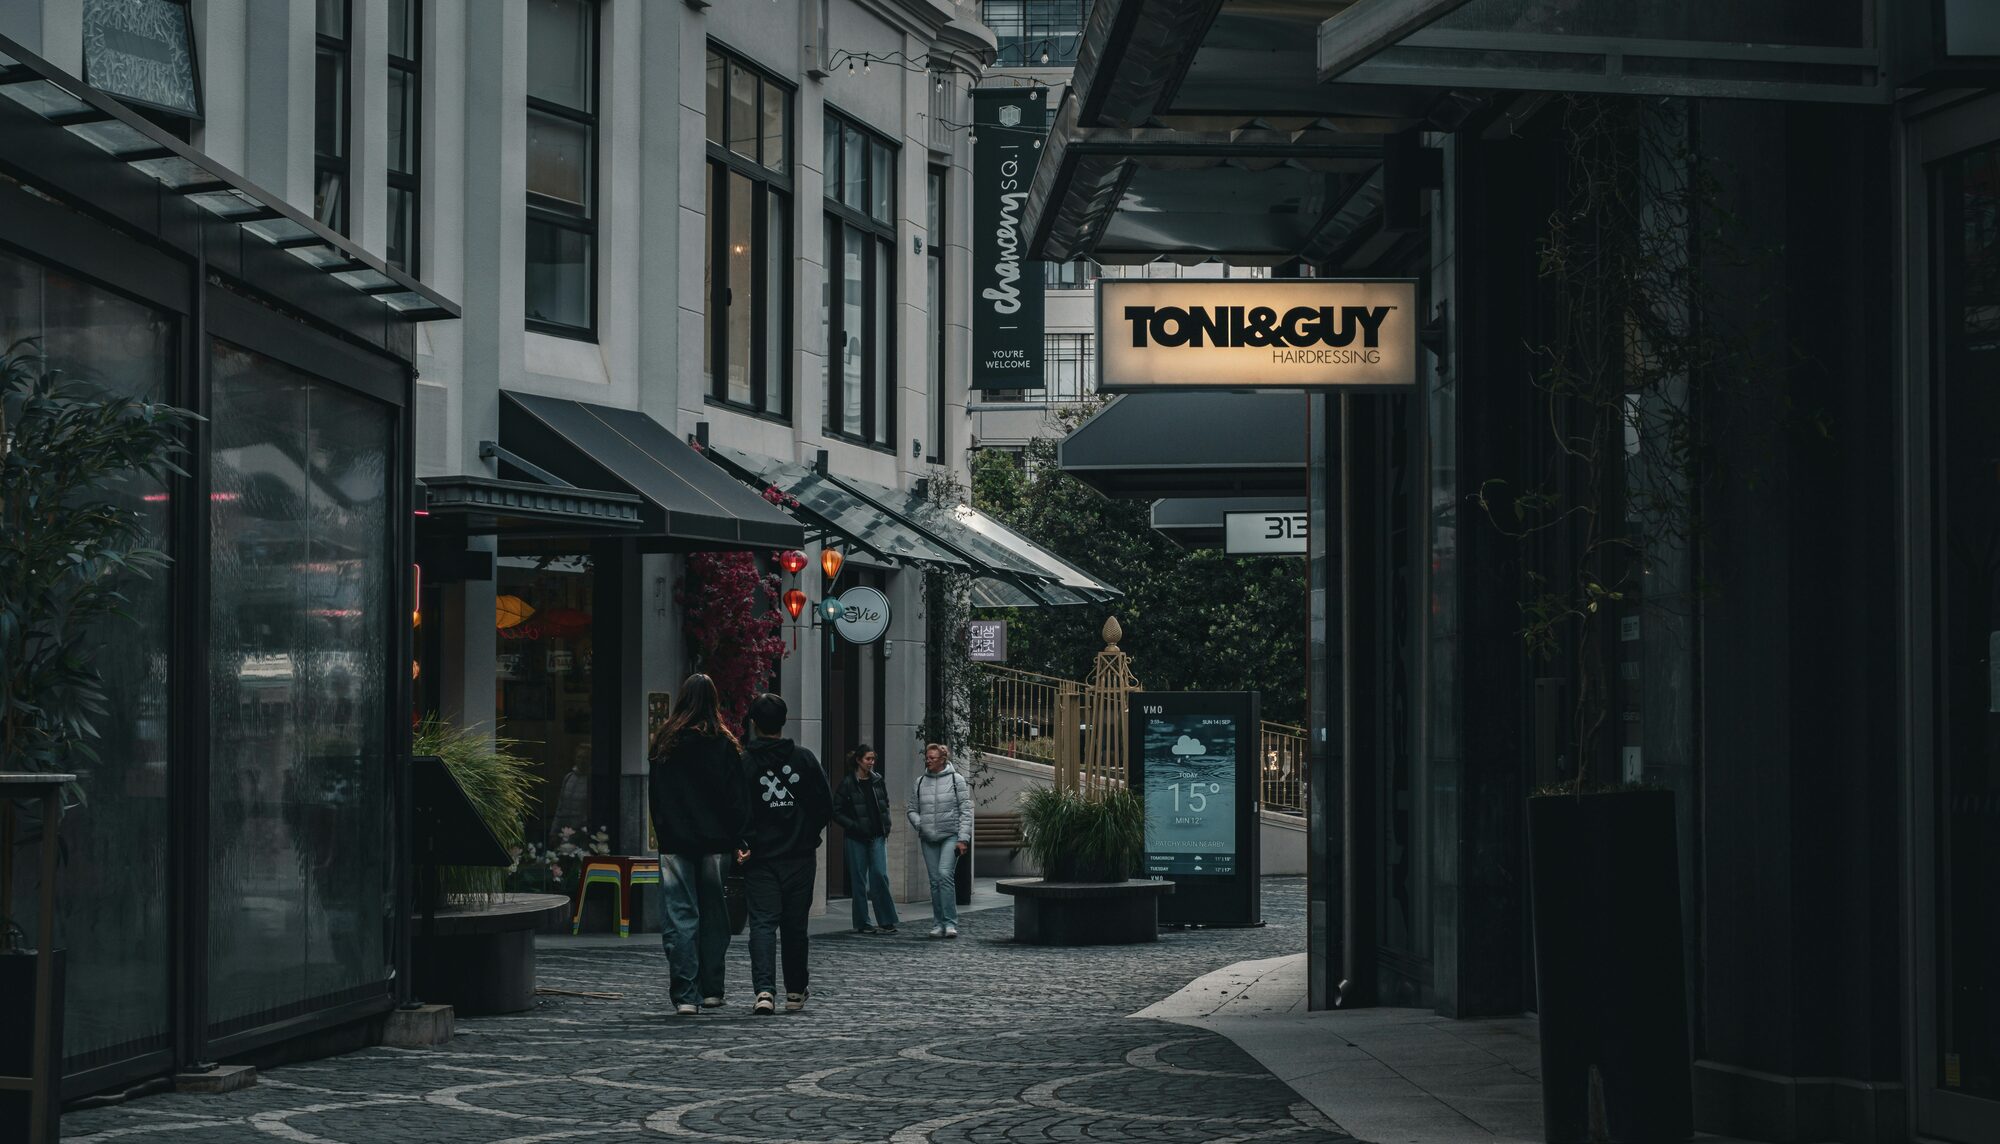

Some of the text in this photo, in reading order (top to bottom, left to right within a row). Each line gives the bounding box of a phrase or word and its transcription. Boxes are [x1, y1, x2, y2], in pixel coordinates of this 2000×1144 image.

[982, 191, 1028, 315] chancery
[992, 350, 1024, 358] YOU'RE
[1272, 350, 1380, 364] HAIRDRESSING
[985, 360, 1031, 369] WELCOME
[856, 606, 880, 621] Vie
[1143, 705, 1163, 715] VMO
[1167, 782, 1220, 812] 15°
[1155, 840, 1225, 848] PATCHY RAIN NEARBY
